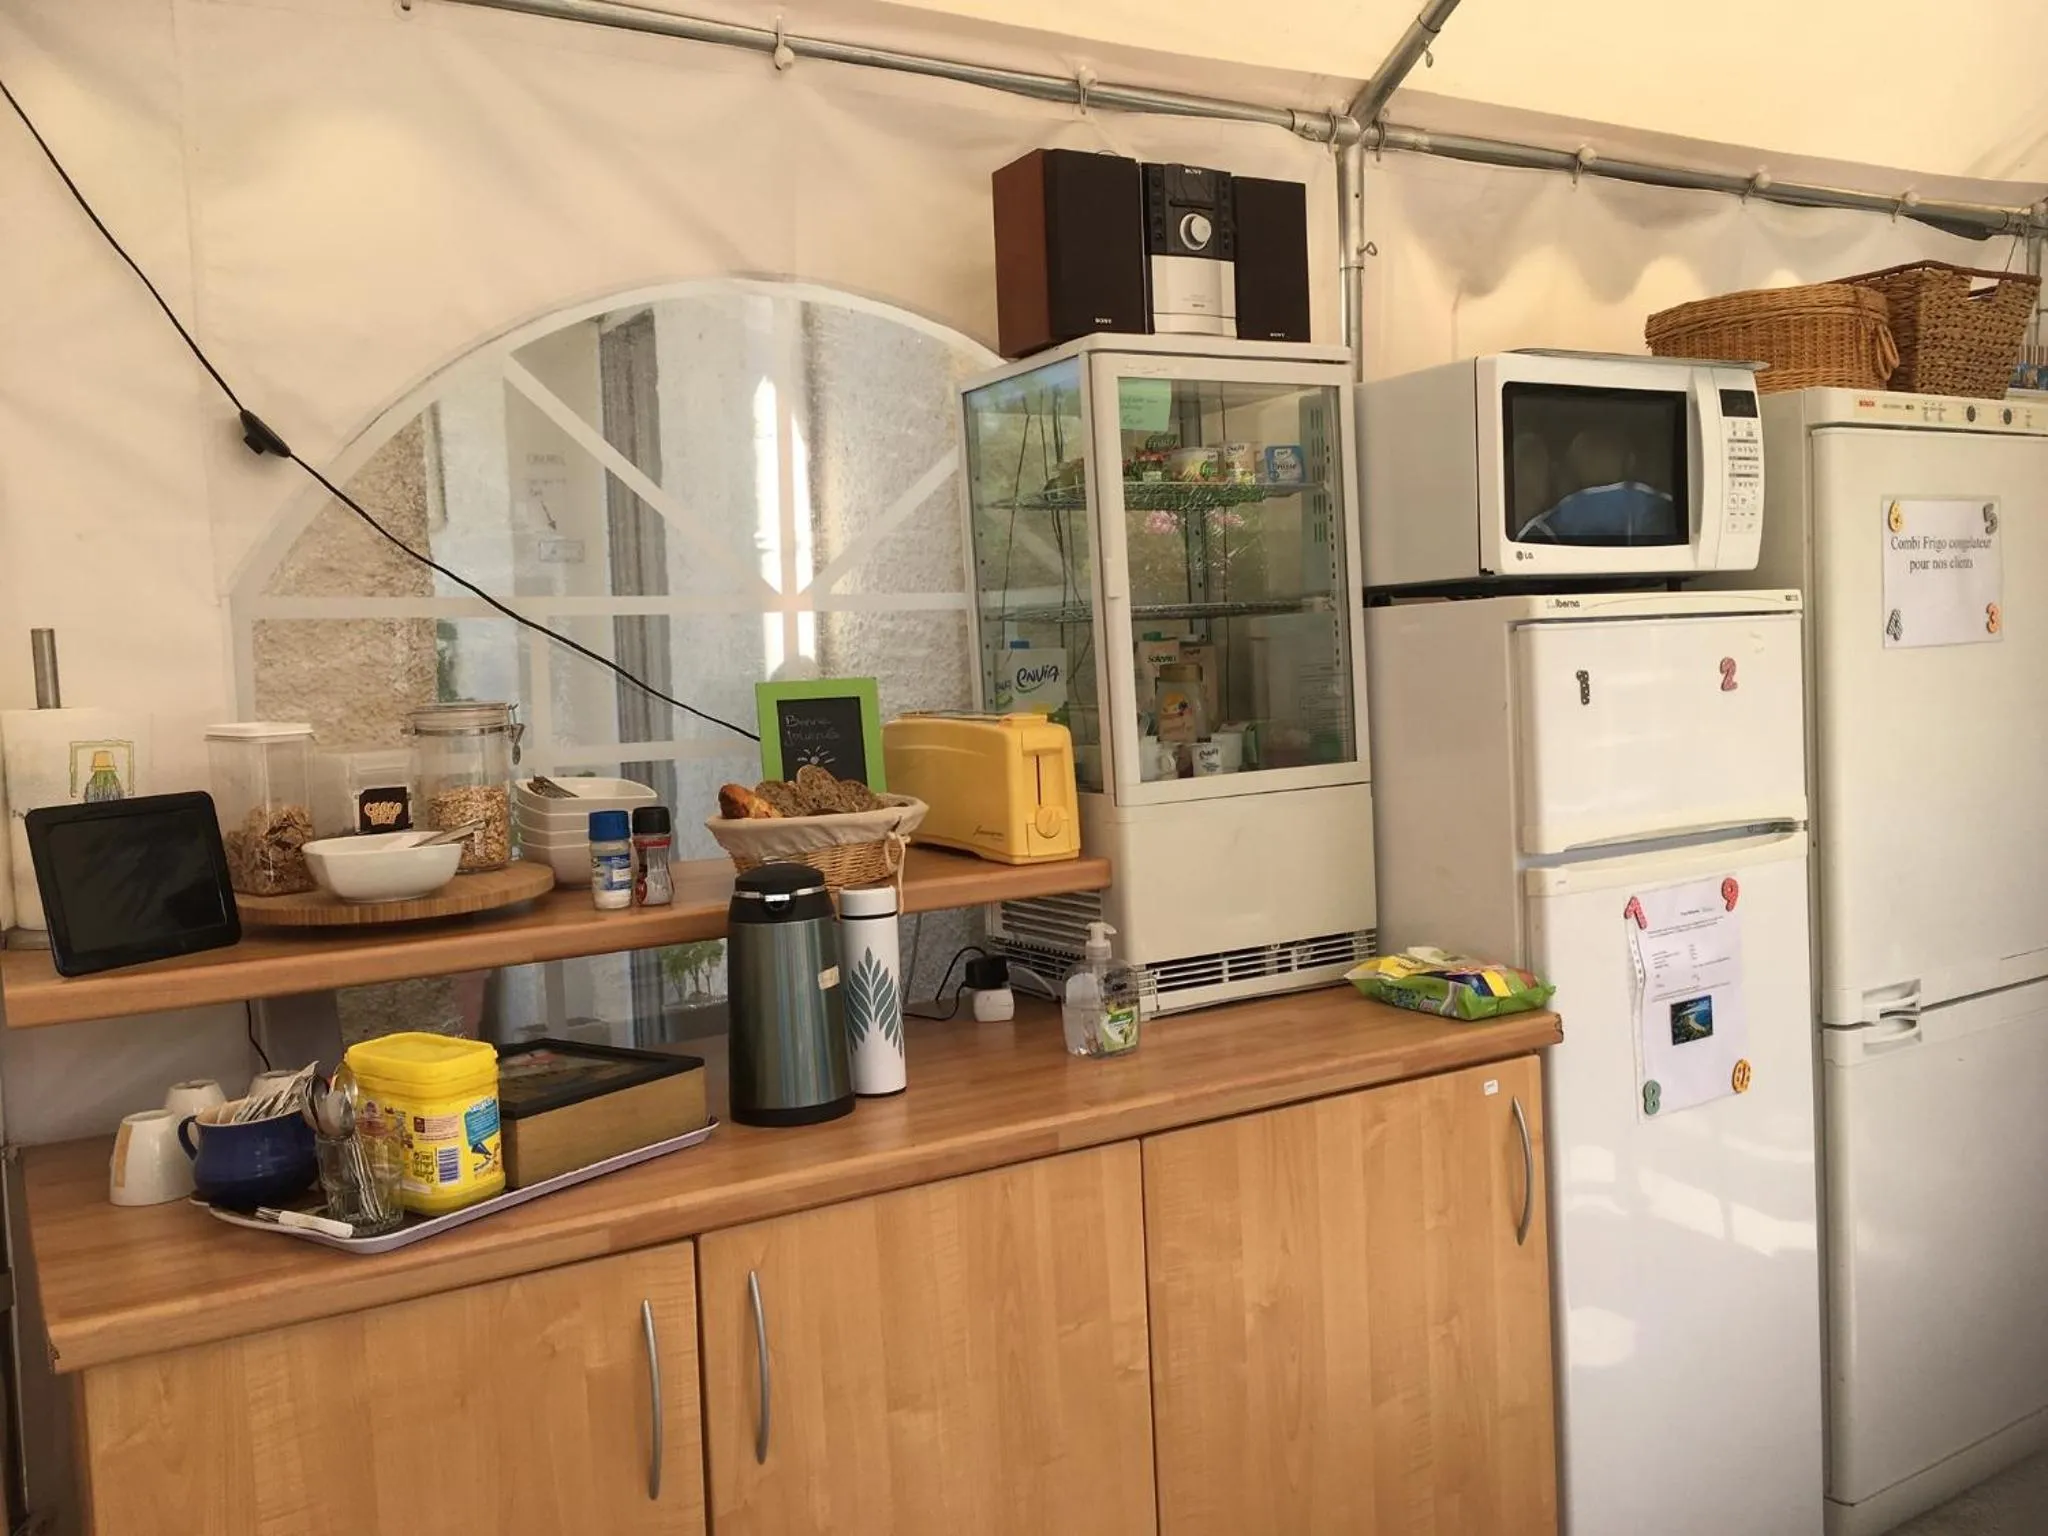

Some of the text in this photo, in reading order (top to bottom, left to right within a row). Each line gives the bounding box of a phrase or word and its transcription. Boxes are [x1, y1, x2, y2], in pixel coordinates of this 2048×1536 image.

[1094, 316, 1113, 325] SONY
[1982, 502, 1998, 535] 5
[1890, 536, 1921, 550] Combi
[1923, 536, 1948, 553] Frigo
[1909, 556, 1974, 575] pour nos clients
[1986, 601, 2000, 634] 3
[1576, 670, 1590, 705] 1
[1719, 656, 1738, 692] 2
[1721, 877, 1740, 912] 9
[1643, 1079, 1662, 1115] 8
